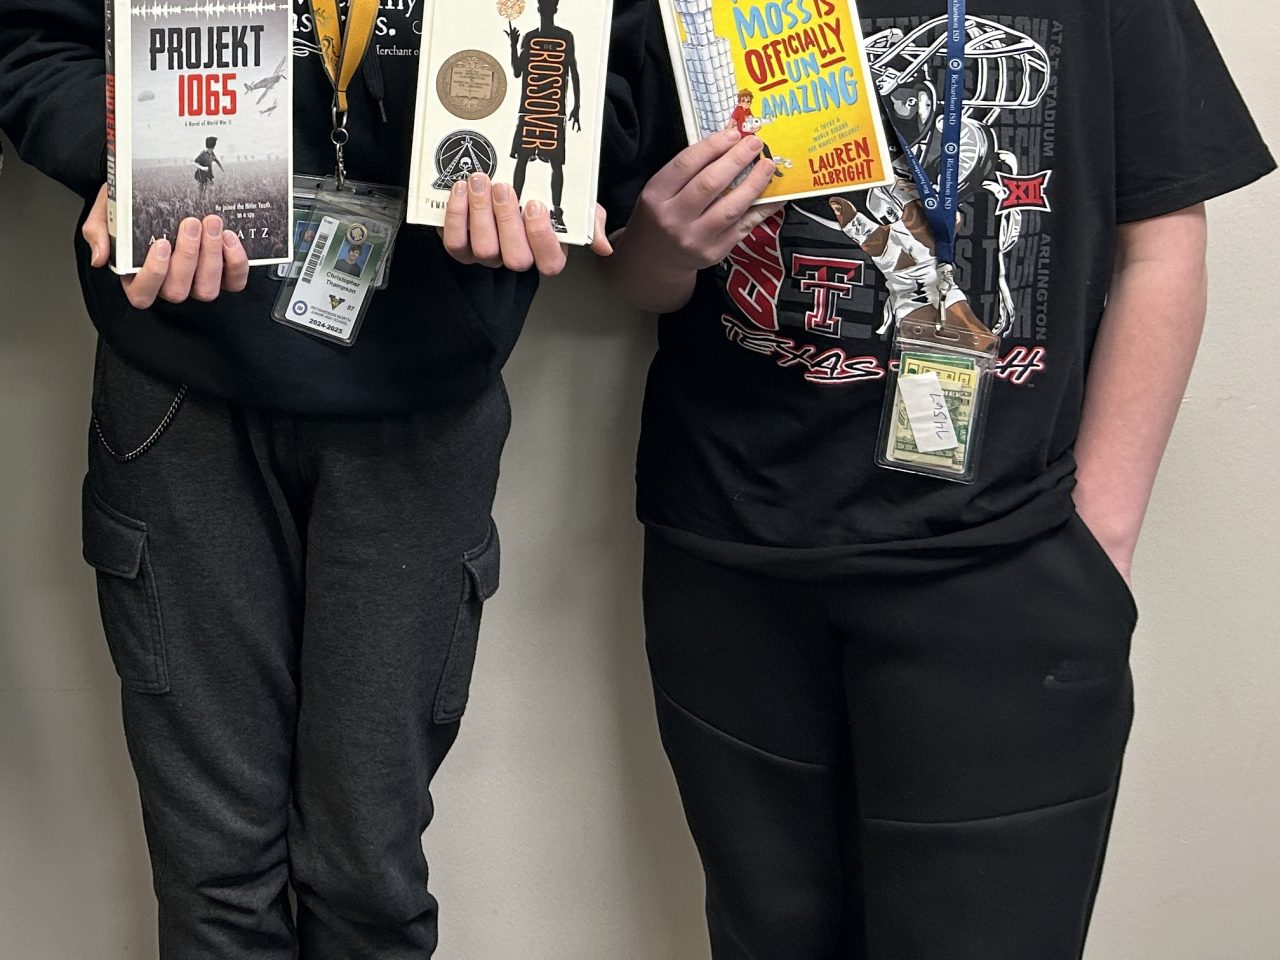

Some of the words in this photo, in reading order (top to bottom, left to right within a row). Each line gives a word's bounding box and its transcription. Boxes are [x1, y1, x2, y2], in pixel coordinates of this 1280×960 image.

[149, 24, 266, 71] PROJEKT
[743, 17, 845, 86] OFFICIALLY
[952, 29, 960, 42] ISD
[1048, 20, 1064, 71] AT&T
[785, 52, 820, 84] UN
[178, 73, 238, 117] 1065
[521, 37, 567, 151] CROSSOVER
[761, 66, 858, 120] AMAZING
[949, 74, 959, 111] Richardson
[948, 112, 956, 126] ISD
[1042, 75, 1059, 157] STADIUM
[808, 136, 870, 174] LAUREN
[813, 159, 874, 187] ALLBRIGHT
[945, 158, 955, 197] Richardson
[222, 202, 236, 212] joined
[236, 203, 245, 211] the
[245, 201, 257, 209] Hitler
[430, 199, 448, 210] KWA
[944, 197, 952, 210] ISD
[237, 227, 270, 240] ATZ
[326, 271, 361, 287] Christopher
[326, 279, 356, 295] Thompson
[1035, 233, 1052, 340] ARLINGTON
[308, 318, 344, 334] 2024-2025
[721, 313, 886, 385] TEXAS
